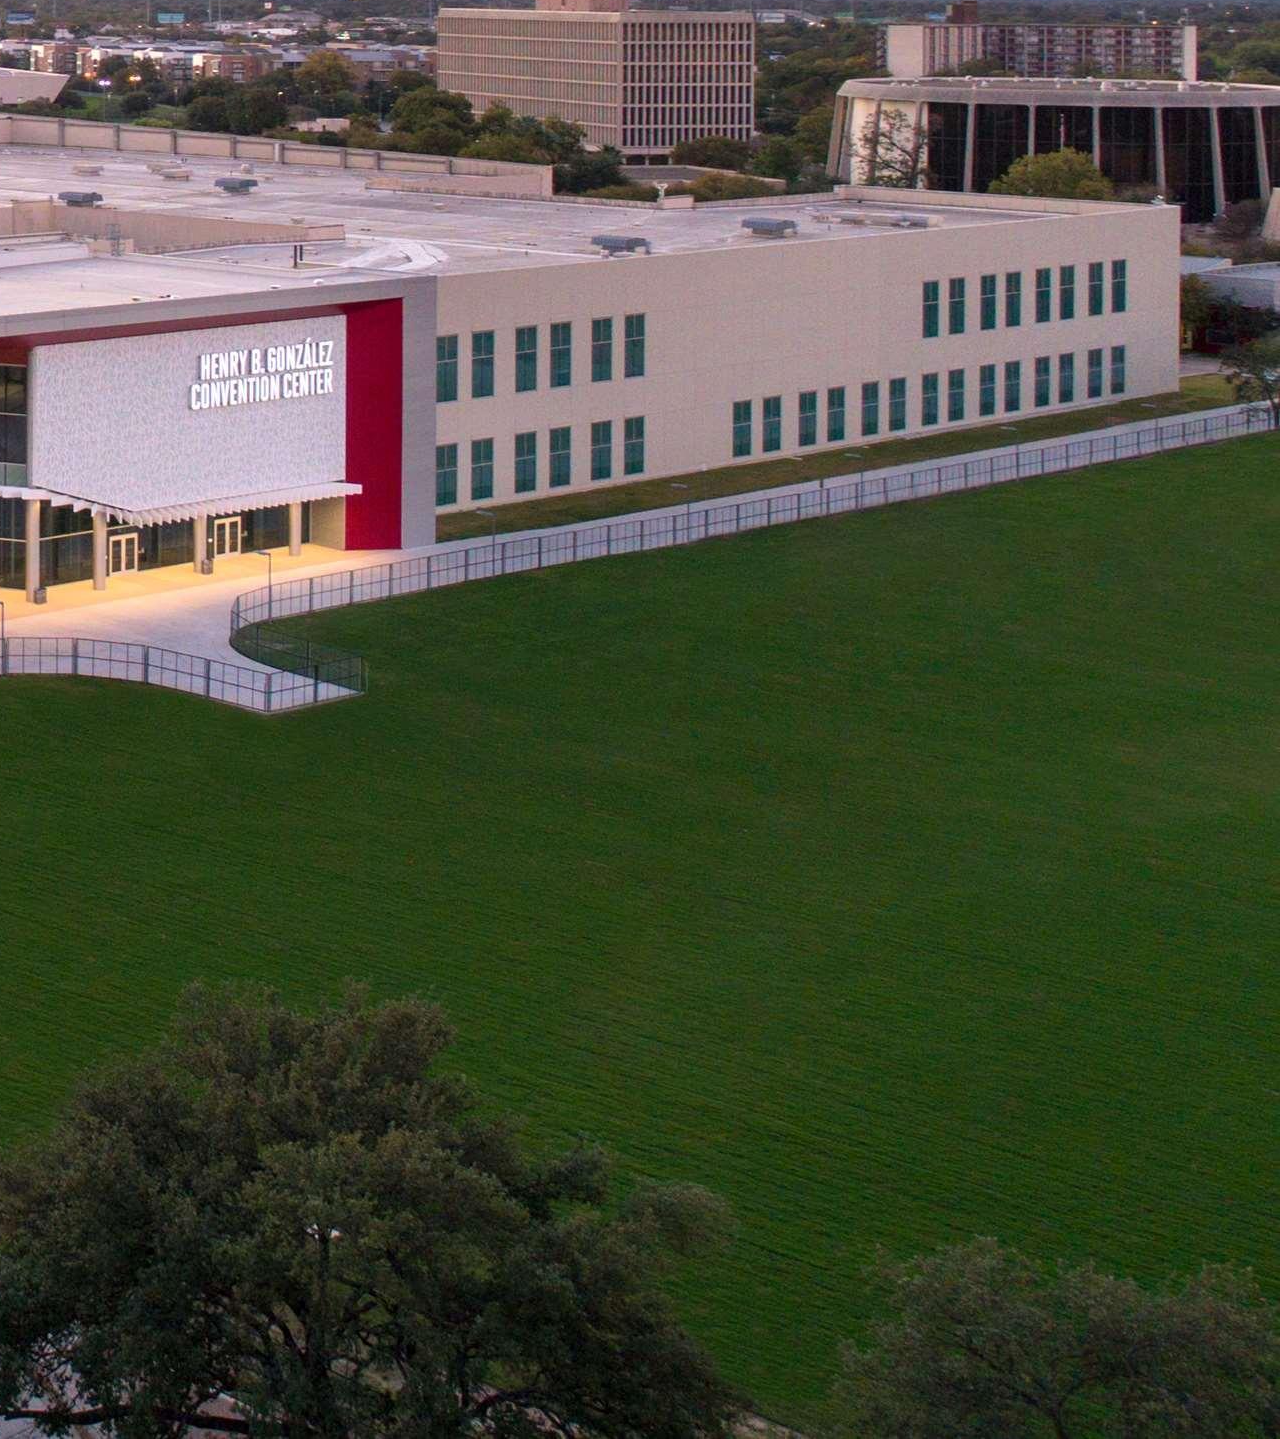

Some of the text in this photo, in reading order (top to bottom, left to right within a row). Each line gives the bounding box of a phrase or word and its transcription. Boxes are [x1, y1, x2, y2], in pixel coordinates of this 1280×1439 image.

[200, 337, 334, 380] HENRY B. GONZÁLEZ
[190, 368, 334, 411] CONVENTION CENTER
